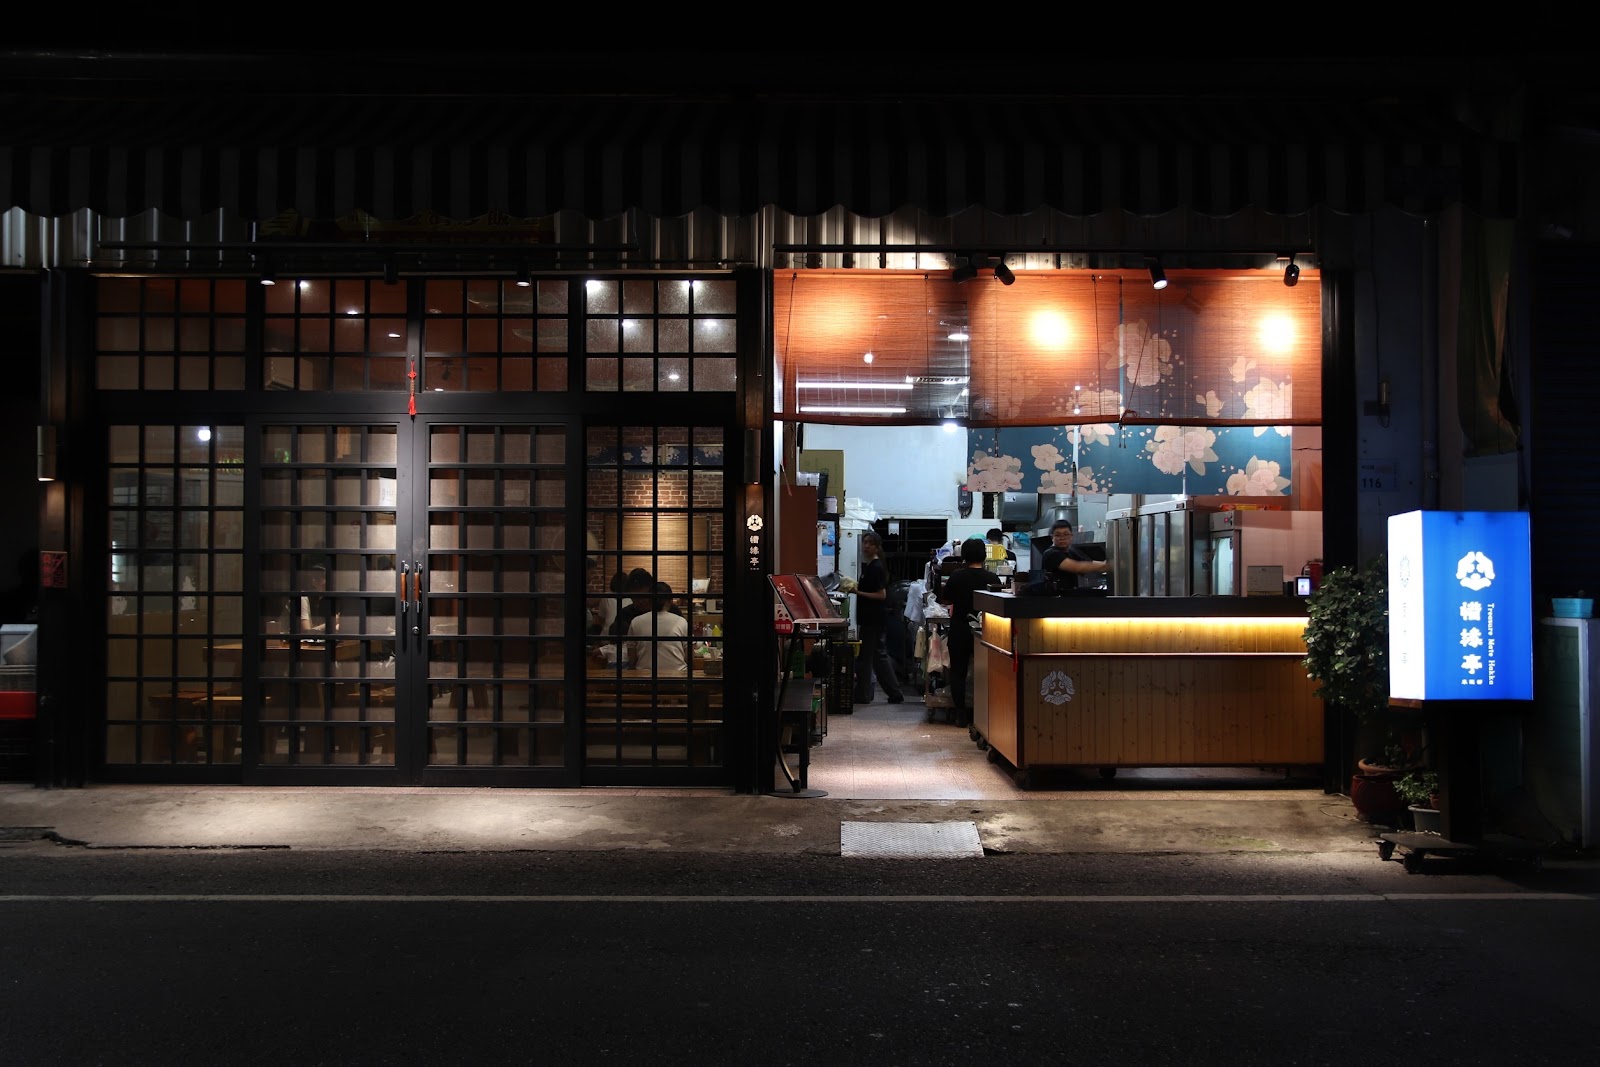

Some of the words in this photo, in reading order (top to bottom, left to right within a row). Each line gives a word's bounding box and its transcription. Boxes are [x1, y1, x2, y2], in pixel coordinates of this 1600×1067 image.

[1362, 478, 1382, 488] 116
[749, 535, 760, 566] 惜緣亭
[1487, 603, 1495, 636] Treasure
[1459, 601, 1483, 675] 惜緣亭
[1488, 660, 1496, 685] Hakka
